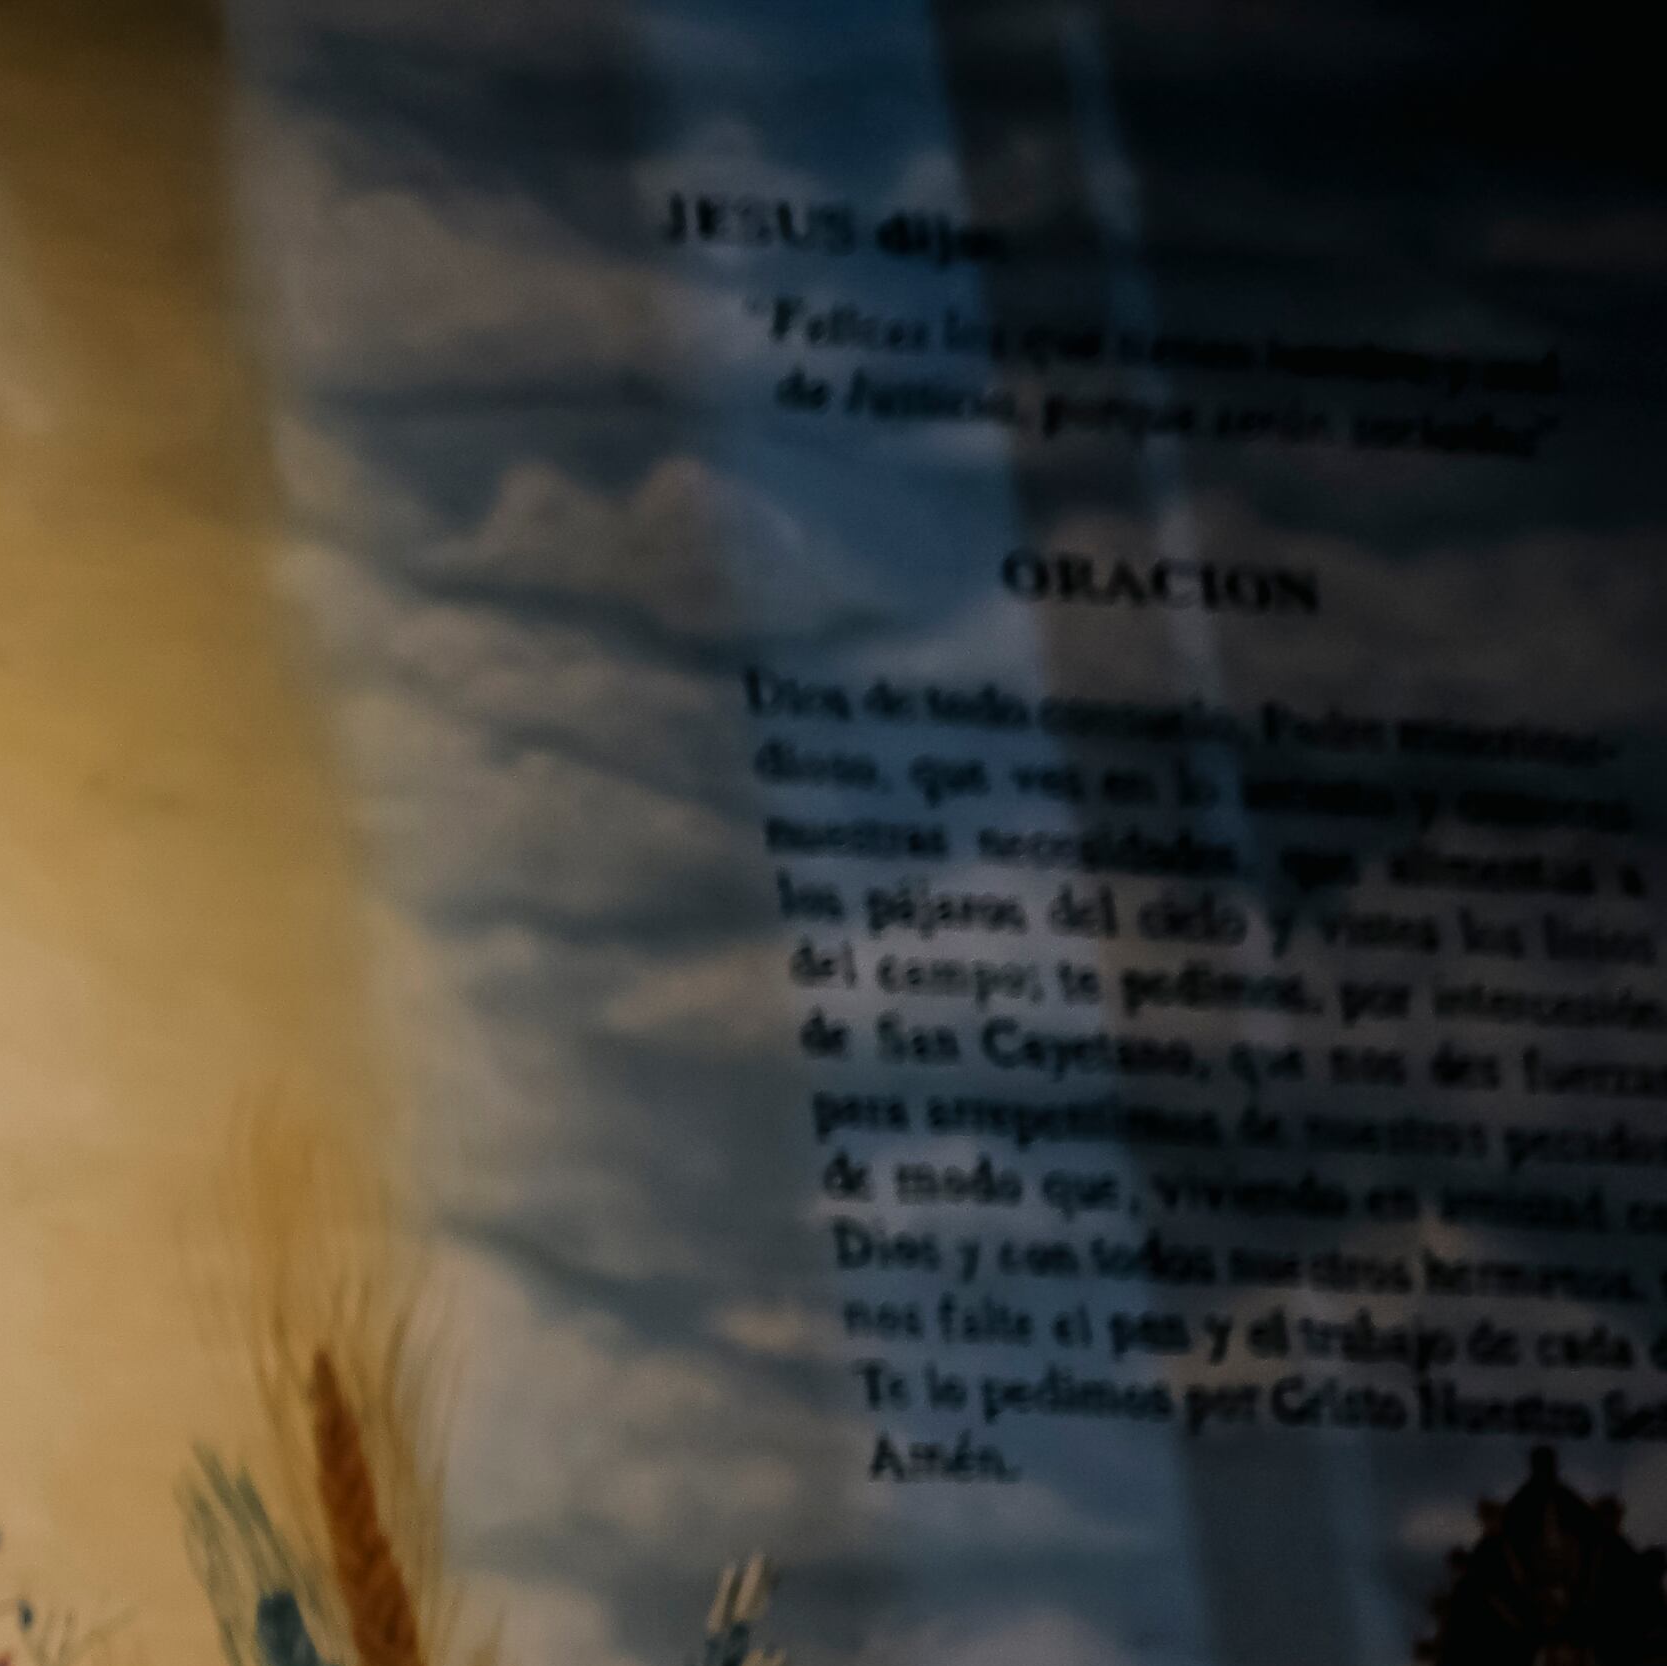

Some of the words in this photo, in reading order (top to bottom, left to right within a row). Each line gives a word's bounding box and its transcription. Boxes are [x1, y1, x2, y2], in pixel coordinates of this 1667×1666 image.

[665, 192, 857, 257] JESUS
[1002, 550, 1320, 616] ORACION
[746, 667, 852, 720] Dios
[865, 678, 910, 722] de
[925, 682, 1029, 732] todo
[910, 755, 987, 808] que
[777, 866, 847, 920] los
[867, 875, 1027, 938] pájaros
[1050, 885, 1117, 938] del
[1270, 906, 1297, 958] y
[790, 938, 857, 988] del
[1057, 960, 1101, 1002] te
[1340, 980, 1409, 1026] por
[800, 1006, 847, 1060] de
[877, 1012, 959, 1065] San
[1229, 1040, 1305, 1090] que
[1329, 1042, 1405, 1086] nos
[813, 1092, 909, 1144] para
[822, 1150, 867, 1202] de
[895, 1152, 1023, 1208] modo
[1365, 1182, 1419, 1222] en
[832, 1215, 939, 1272] Dios
[955, 1236, 979, 1285] y
[997, 1238, 1079, 1278] con
[1090, 1230, 1217, 1285] todos
[843, 1300, 923, 1342] nos
[937, 1292, 1033, 1348] falte
[1053, 1303, 1093, 1350] el
[1109, 1312, 1192, 1362] pan
[1199, 1312, 1235, 1365] y
[1249, 1303, 1289, 1360] el
[1297, 1305, 1459, 1372] trabajo
[1467, 1318, 1519, 1368] de
[1535, 1322, 1634, 1372] cada
[857, 1358, 907, 1412] Te
[923, 1360, 967, 1412] lo
[977, 1366, 1175, 1426] pedimos
[1185, 1382, 1259, 1436] por
[1269, 1374, 1409, 1432] Cristo
[1417, 1378, 1593, 1440] Nuestro
